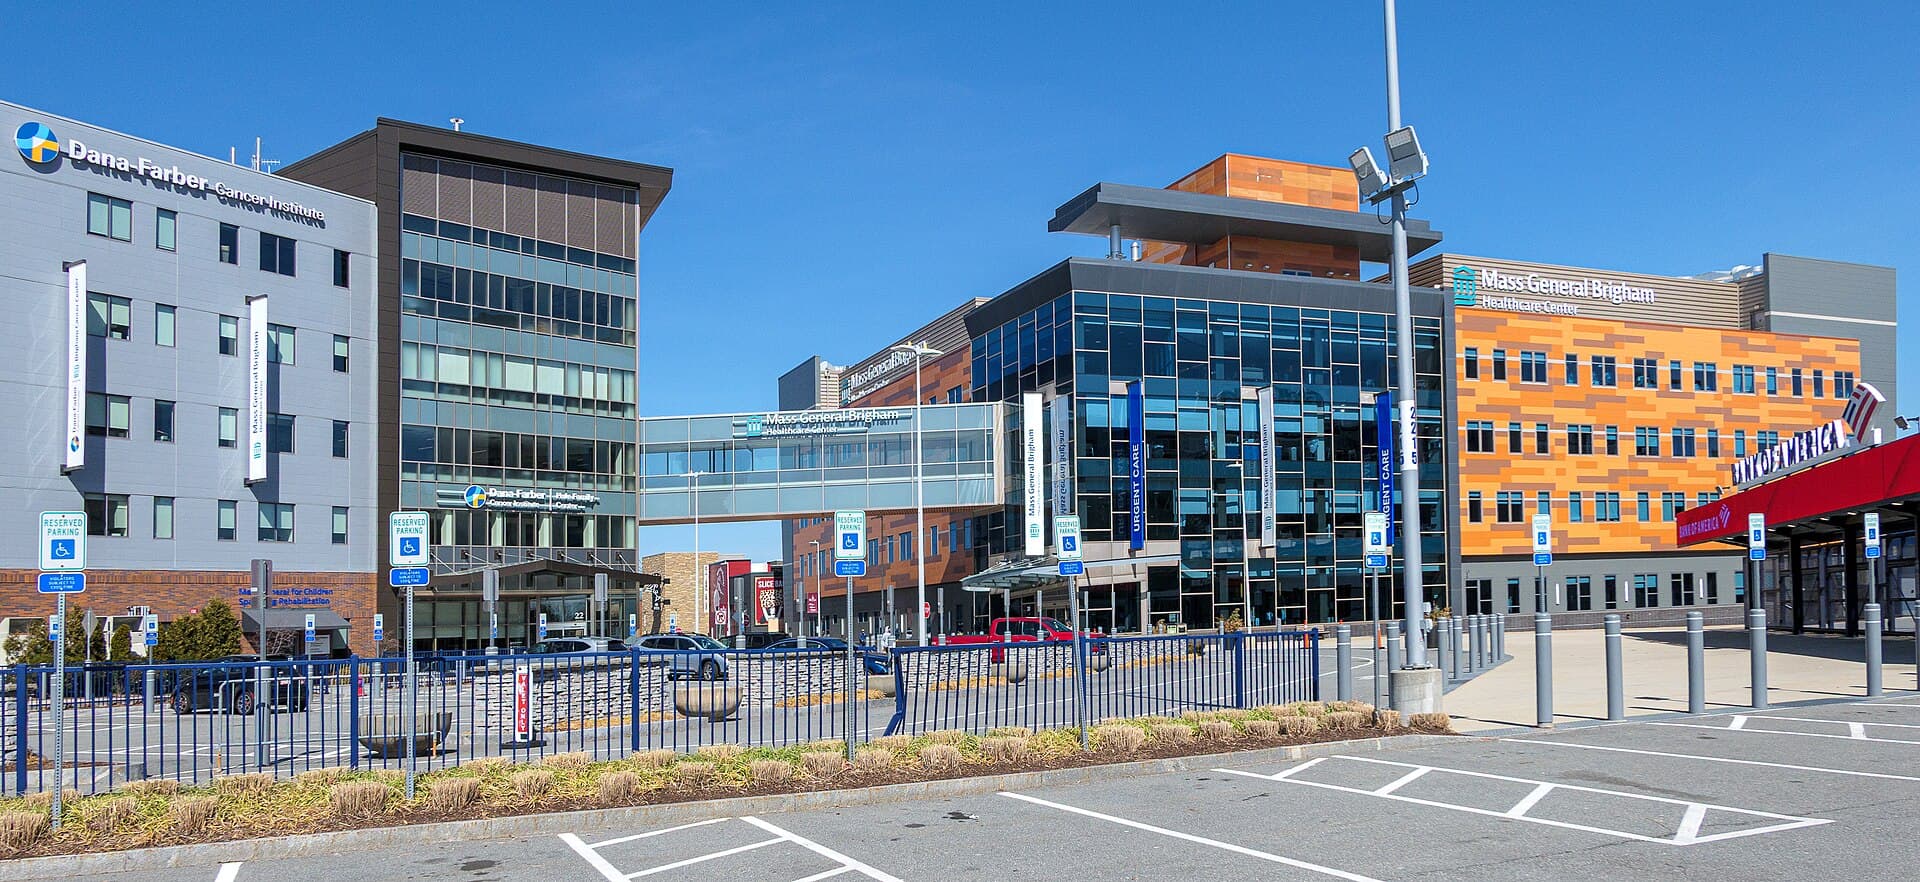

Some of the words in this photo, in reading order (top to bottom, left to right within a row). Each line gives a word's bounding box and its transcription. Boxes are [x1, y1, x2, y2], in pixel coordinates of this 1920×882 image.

[68, 138, 208, 191] Dana-Farber
[215, 182, 266, 206] Cancer
[269, 195, 325, 221] Institute
[1482, 268, 1524, 291] Mass
[1527, 273, 1588, 298] General
[1592, 280, 1655, 305] Brigham
[1482, 295, 1542, 313] Healthcare
[1544, 300, 1578, 316] Center
[252, 331, 260, 370] Brigham
[850, 371, 868, 390] Mass
[867, 351, 895, 380] General
[767, 413, 797, 425] Mass
[800, 411, 846, 424] General
[849, 409, 899, 423] Brigham
[766, 427, 811, 436] Healthcare
[1027, 429, 1036, 462] Brigham
[1132, 443, 1140, 478] CARE
[1381, 449, 1390, 480] CARE
[489, 488, 546, 499] Dana-Farber
[44, 519, 83, 527] RESERVED
[393, 518, 426, 526] RESERVED
[837, 516, 862, 524] RESERVED
[47, 528, 80, 536] PARKING
[757, 580, 774, 588] SLICE
[291, 587, 303, 596] for
[303, 588, 334, 596] Children
[279, 597, 331, 605] Rehabilitation
[574, 612, 584, 620] 22
